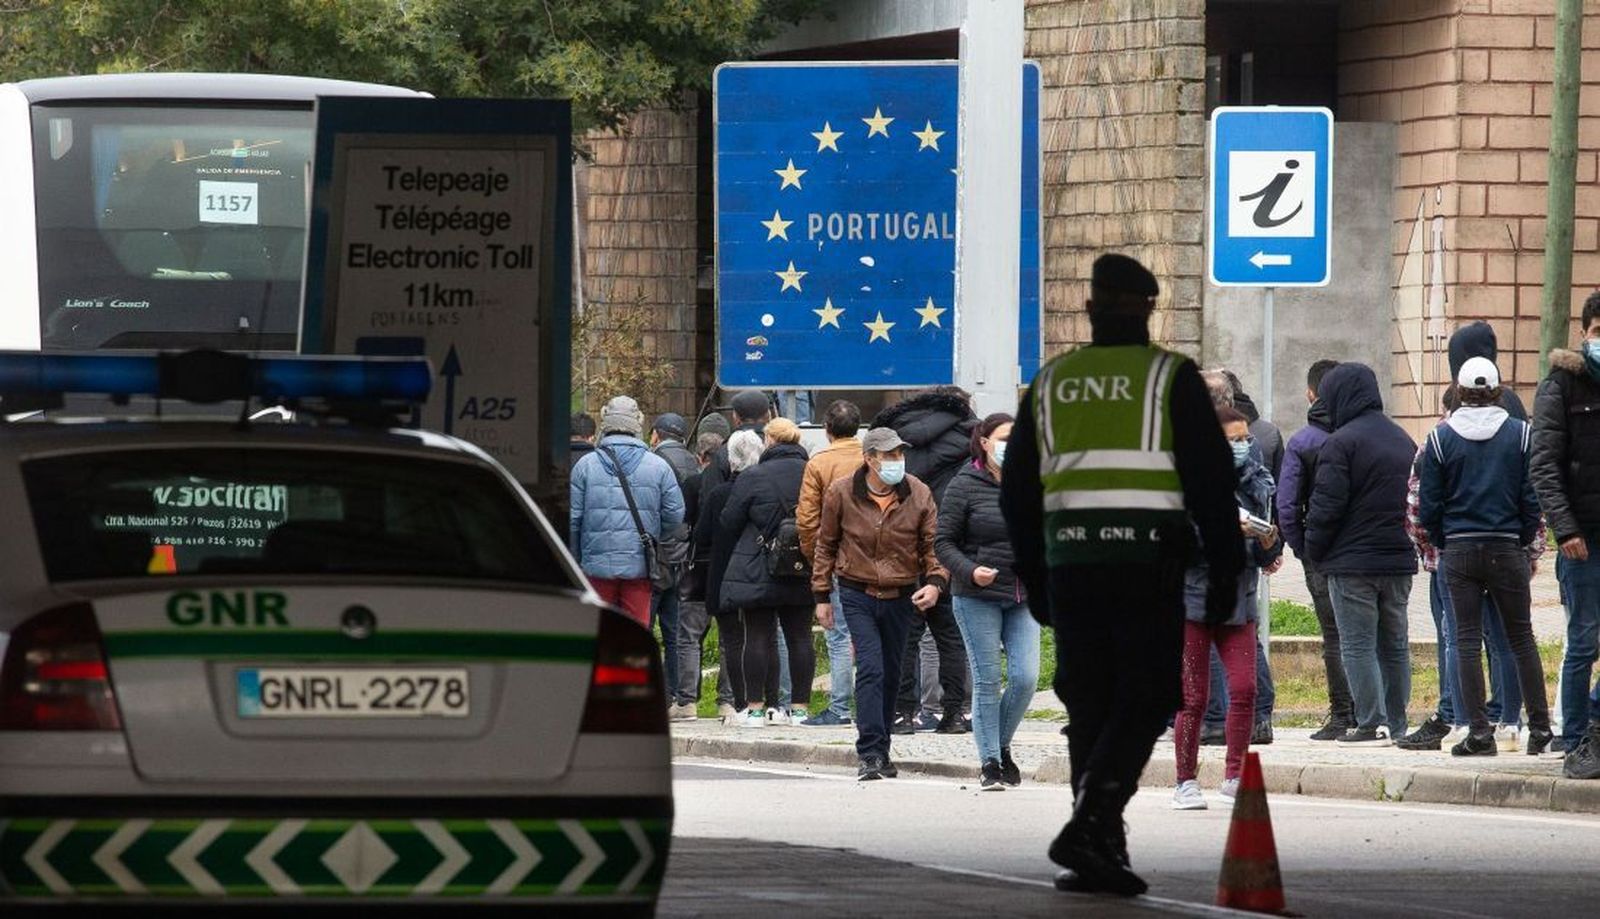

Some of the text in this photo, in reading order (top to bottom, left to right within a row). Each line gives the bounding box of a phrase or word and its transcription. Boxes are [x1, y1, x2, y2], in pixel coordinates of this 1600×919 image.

[382, 166, 509, 196] Telepeaje
[206, 194, 252, 212] 1157
[375, 204, 511, 235] Télépéage
[808, 212, 955, 241] PORTUGAL
[347, 243, 533, 270] Electronic Toll
[65, 298, 150, 308] Lion's Coach
[403, 282, 474, 308] 11km
[1057, 375, 1134, 403] GNR
[459, 396, 517, 421] A25
[127, 514, 169, 526] Nacional
[235, 537, 255, 548] 590
[1056, 525, 1088, 542] GNR
[1099, 525, 1137, 542] GNR
[167, 591, 288, 628] GNR
